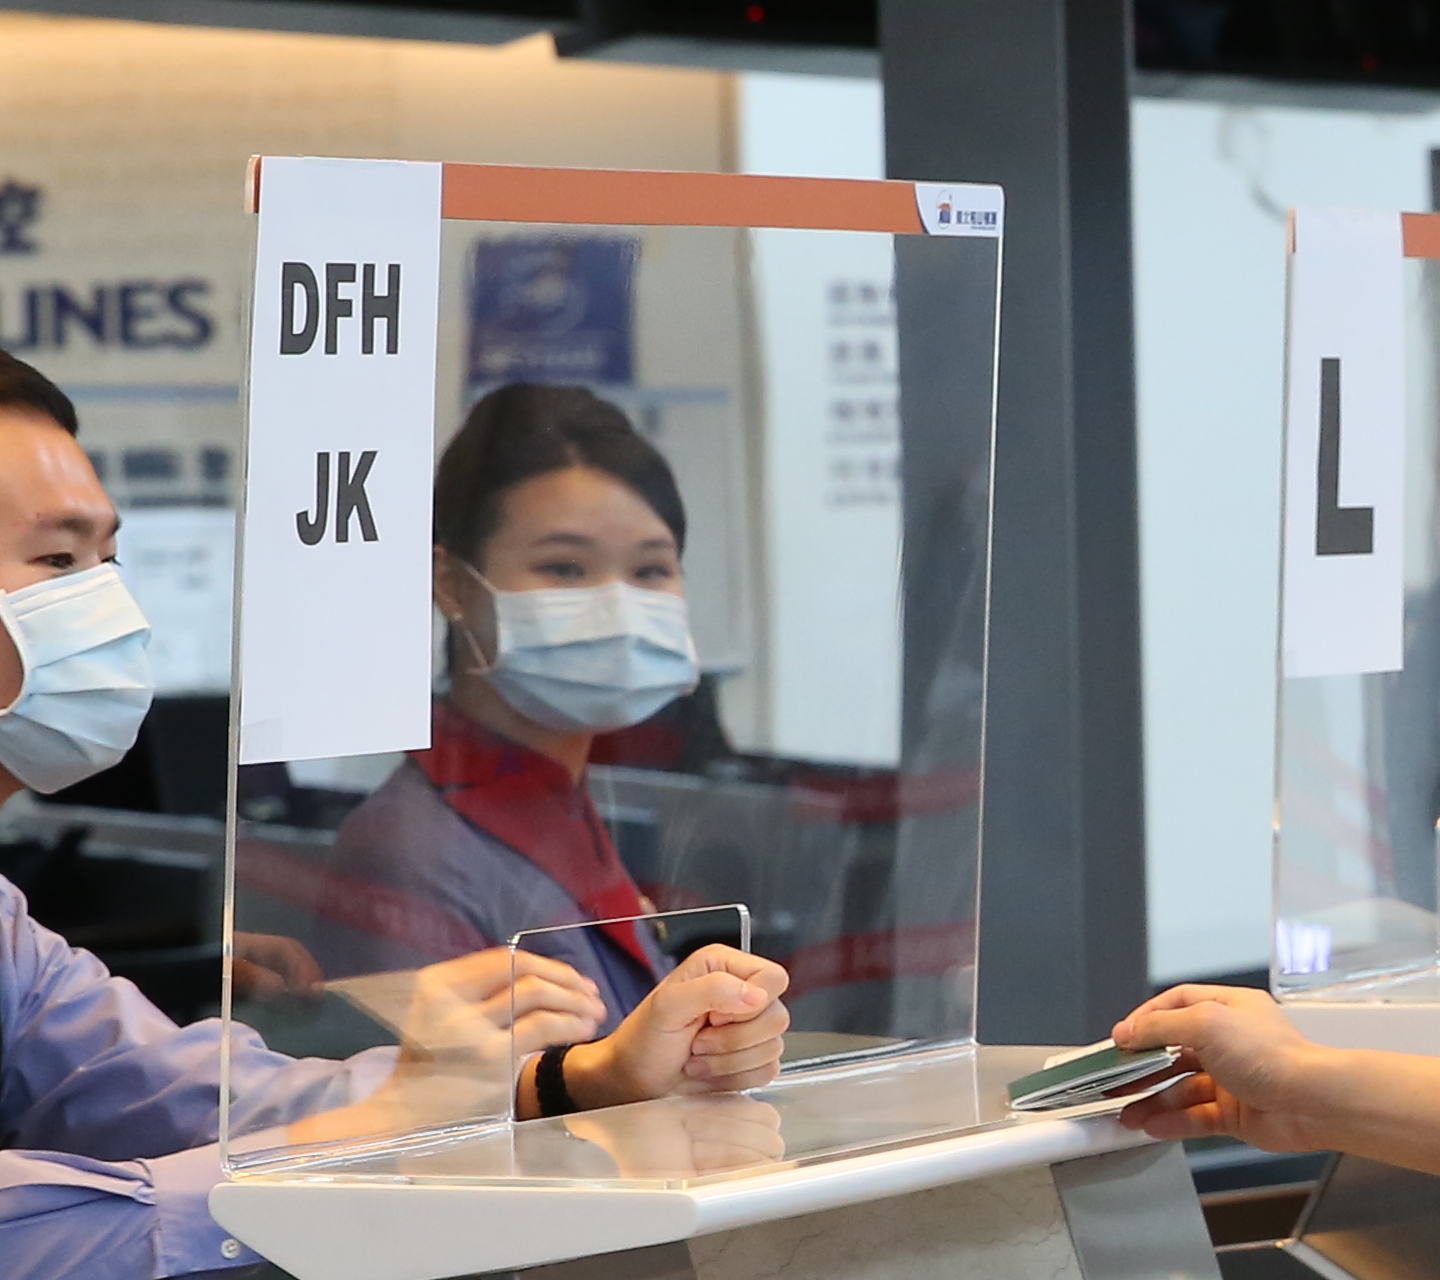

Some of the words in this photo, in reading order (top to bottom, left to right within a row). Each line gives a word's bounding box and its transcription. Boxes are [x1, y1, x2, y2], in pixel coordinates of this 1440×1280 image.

[279, 261, 402, 356] DFH
[295, 450, 380, 547] JK
[1315, 357, 1375, 556] L
